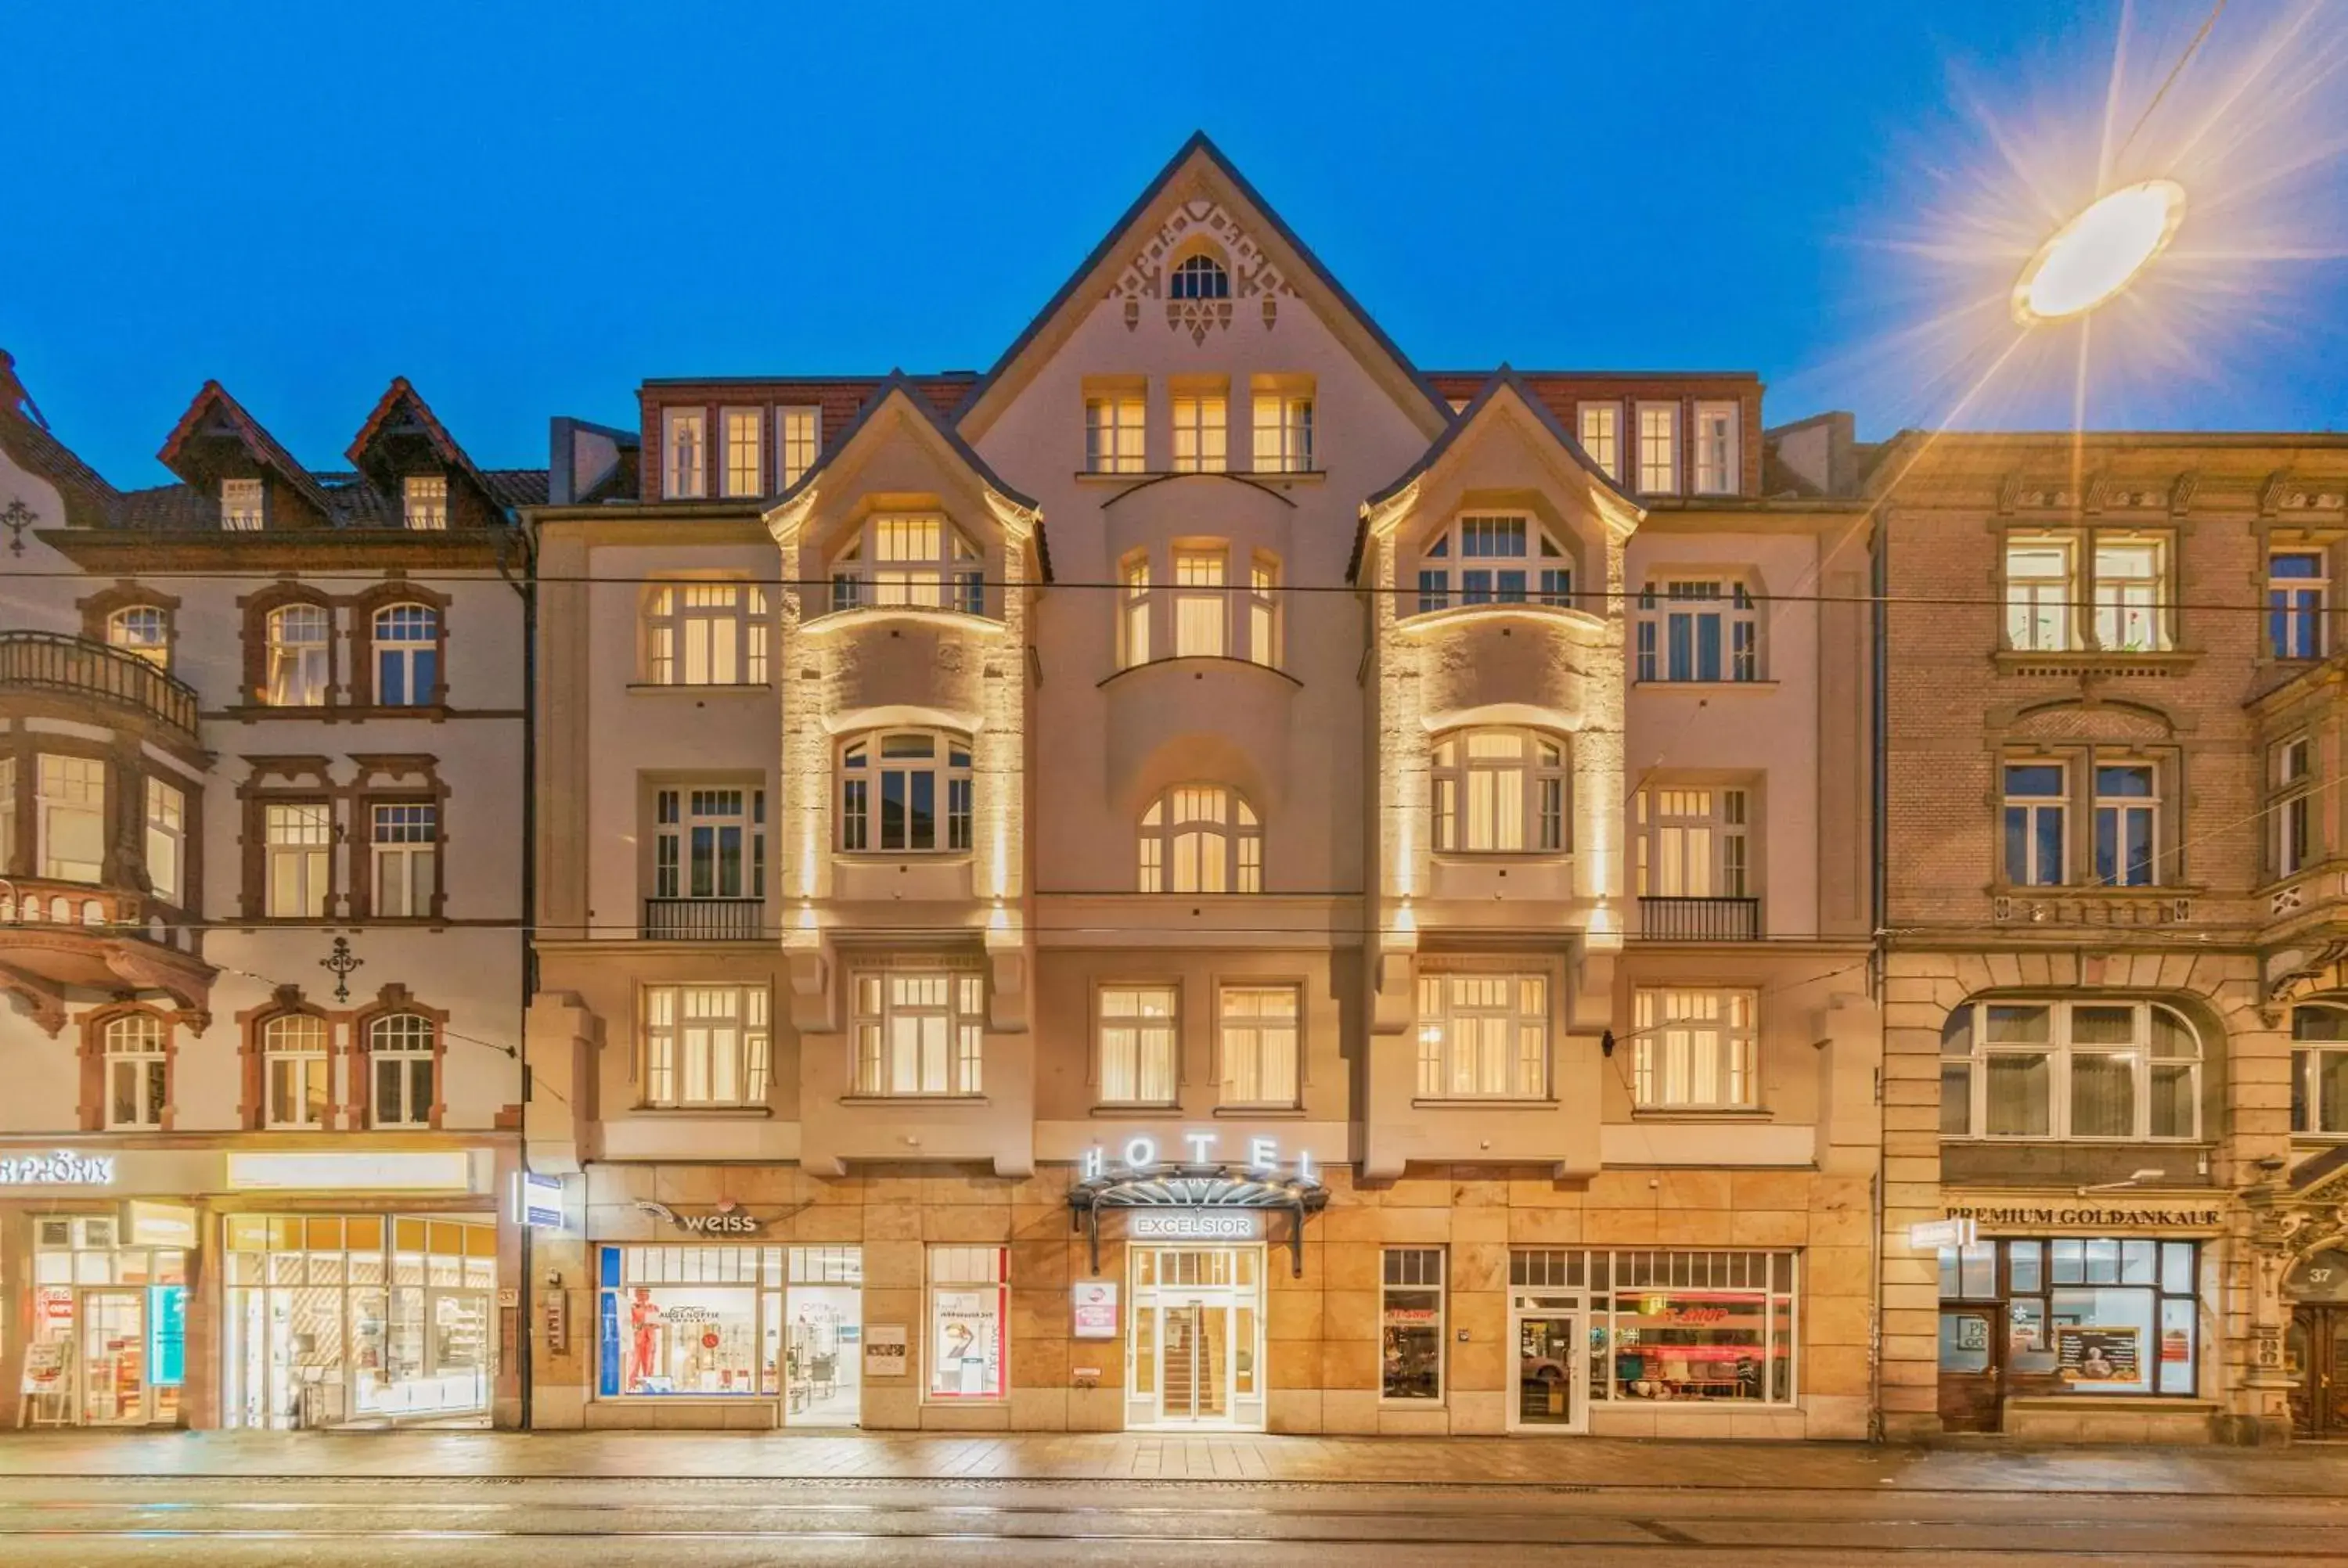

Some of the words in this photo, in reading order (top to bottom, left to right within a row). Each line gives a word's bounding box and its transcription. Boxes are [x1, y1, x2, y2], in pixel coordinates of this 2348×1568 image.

[1086, 1133, 1320, 1186] HOTEL
[683, 1215, 758, 1232] weiss
[1946, 1207, 2053, 1225] PREMIUM
[2060, 1209, 2219, 1225] GOLDANKAUF
[1137, 1218, 1251, 1234] EXCELSIOR
[2310, 1268, 2332, 1282] 37
